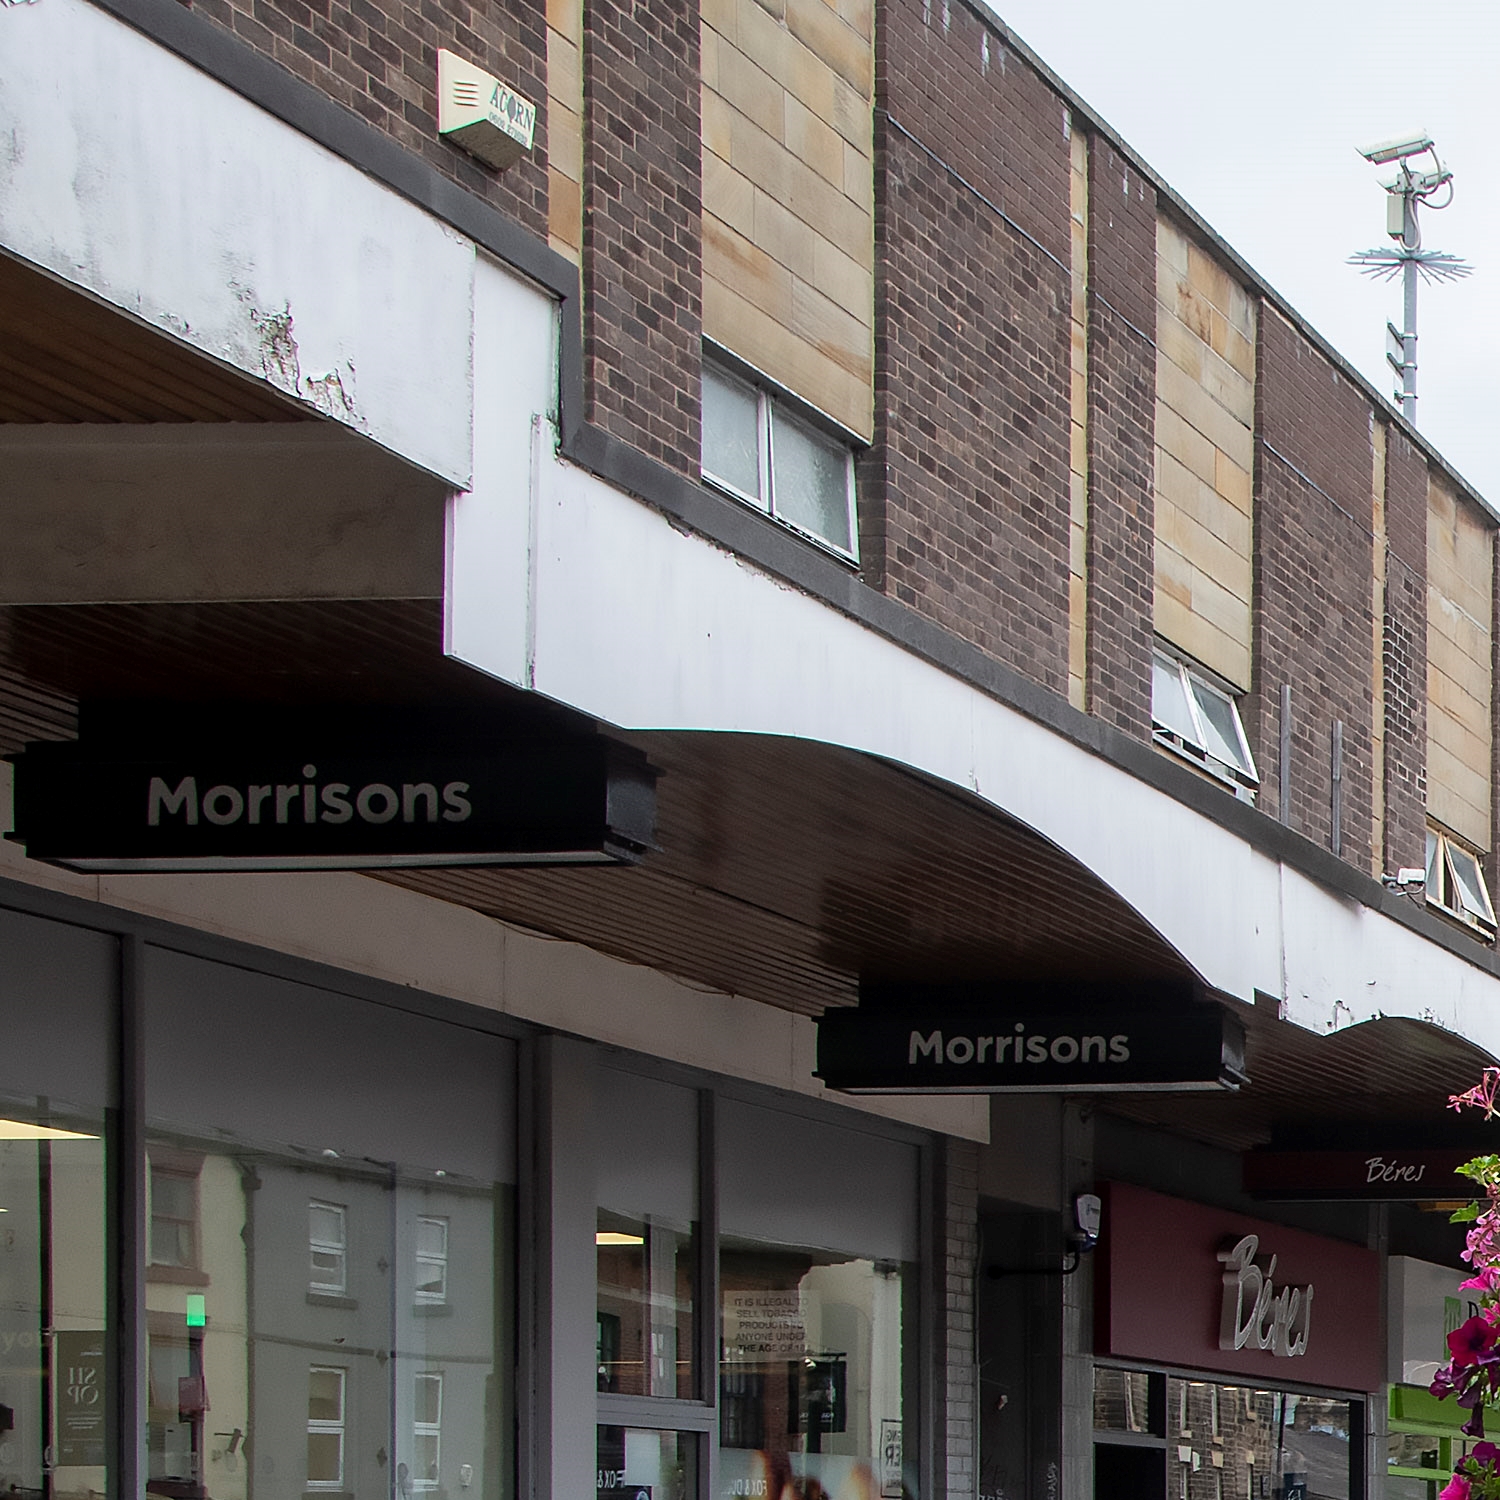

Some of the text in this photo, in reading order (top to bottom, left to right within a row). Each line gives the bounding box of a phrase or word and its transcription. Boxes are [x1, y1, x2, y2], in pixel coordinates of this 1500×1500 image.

[147, 763, 472, 827] Morrisons
[908, 1022, 1131, 1065] Morrisons
[1364, 1156, 1427, 1183] Béres
[734, 1298, 742, 1307] IT
[744, 1298, 754, 1307] IS
[756, 1298, 794, 1307] ILLEGAL
[736, 1309, 759, 1318] SELL
[739, 1320, 789, 1330] PRODUCTS
[735, 1332, 773, 1341] ANYONE
[738, 1344, 756, 1353] THE
[758, 1344, 778, 1353] AGE
